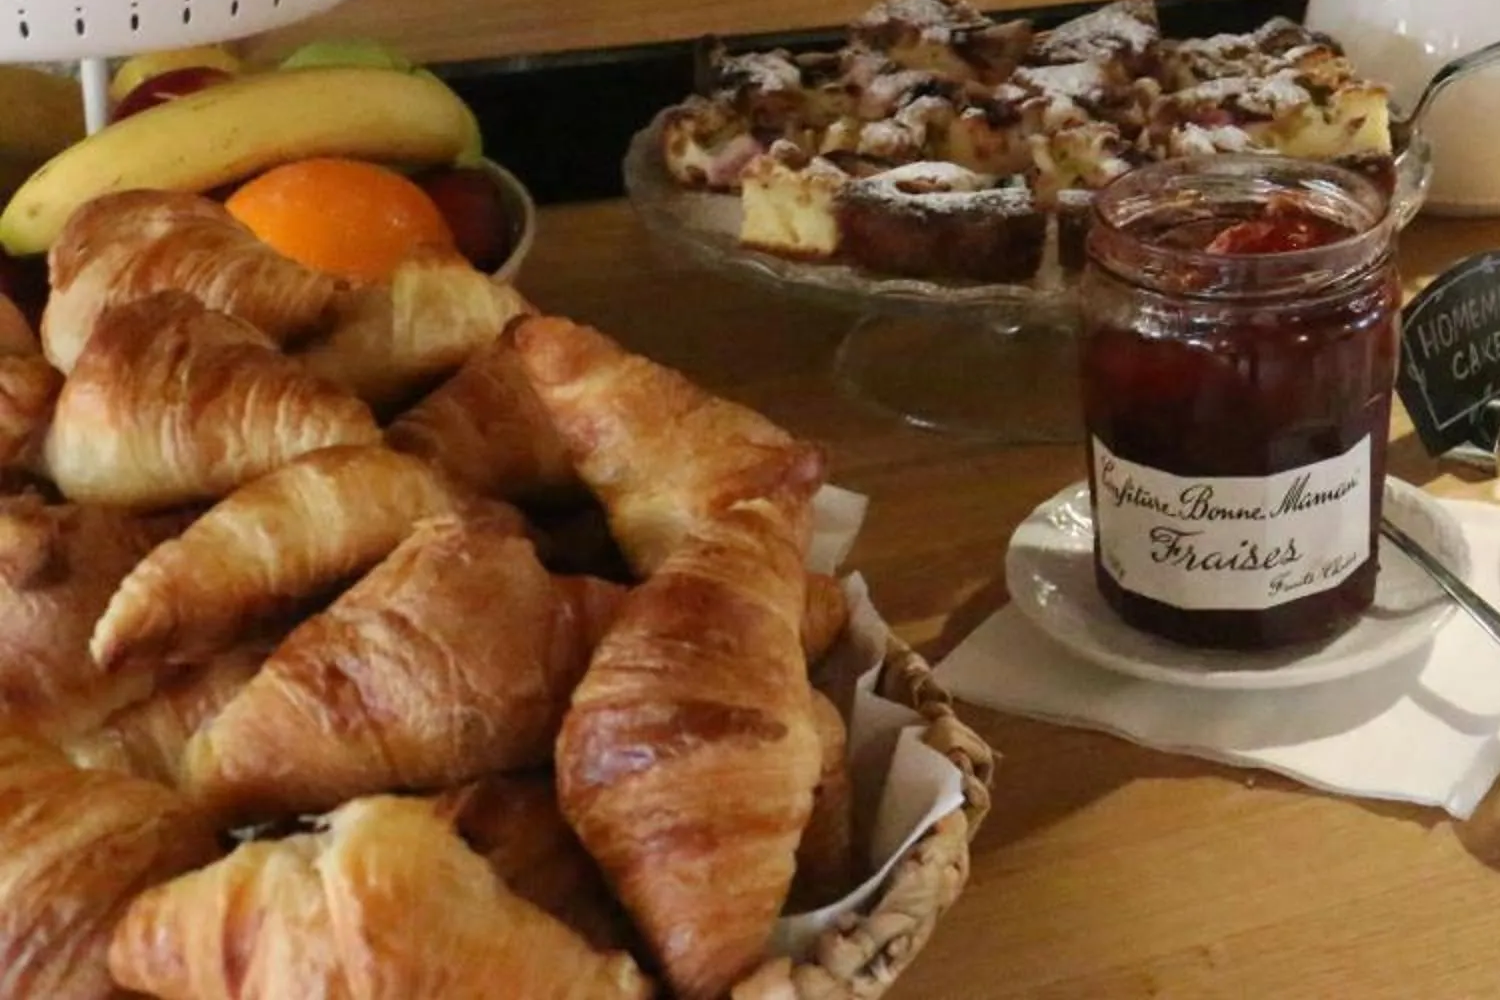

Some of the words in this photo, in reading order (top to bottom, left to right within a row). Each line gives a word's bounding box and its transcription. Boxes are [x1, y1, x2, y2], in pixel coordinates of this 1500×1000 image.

[1178, 483, 1266, 521] Bonne
[1269, 471, 1360, 519] Maman
[1149, 525, 1304, 572] Fraises
